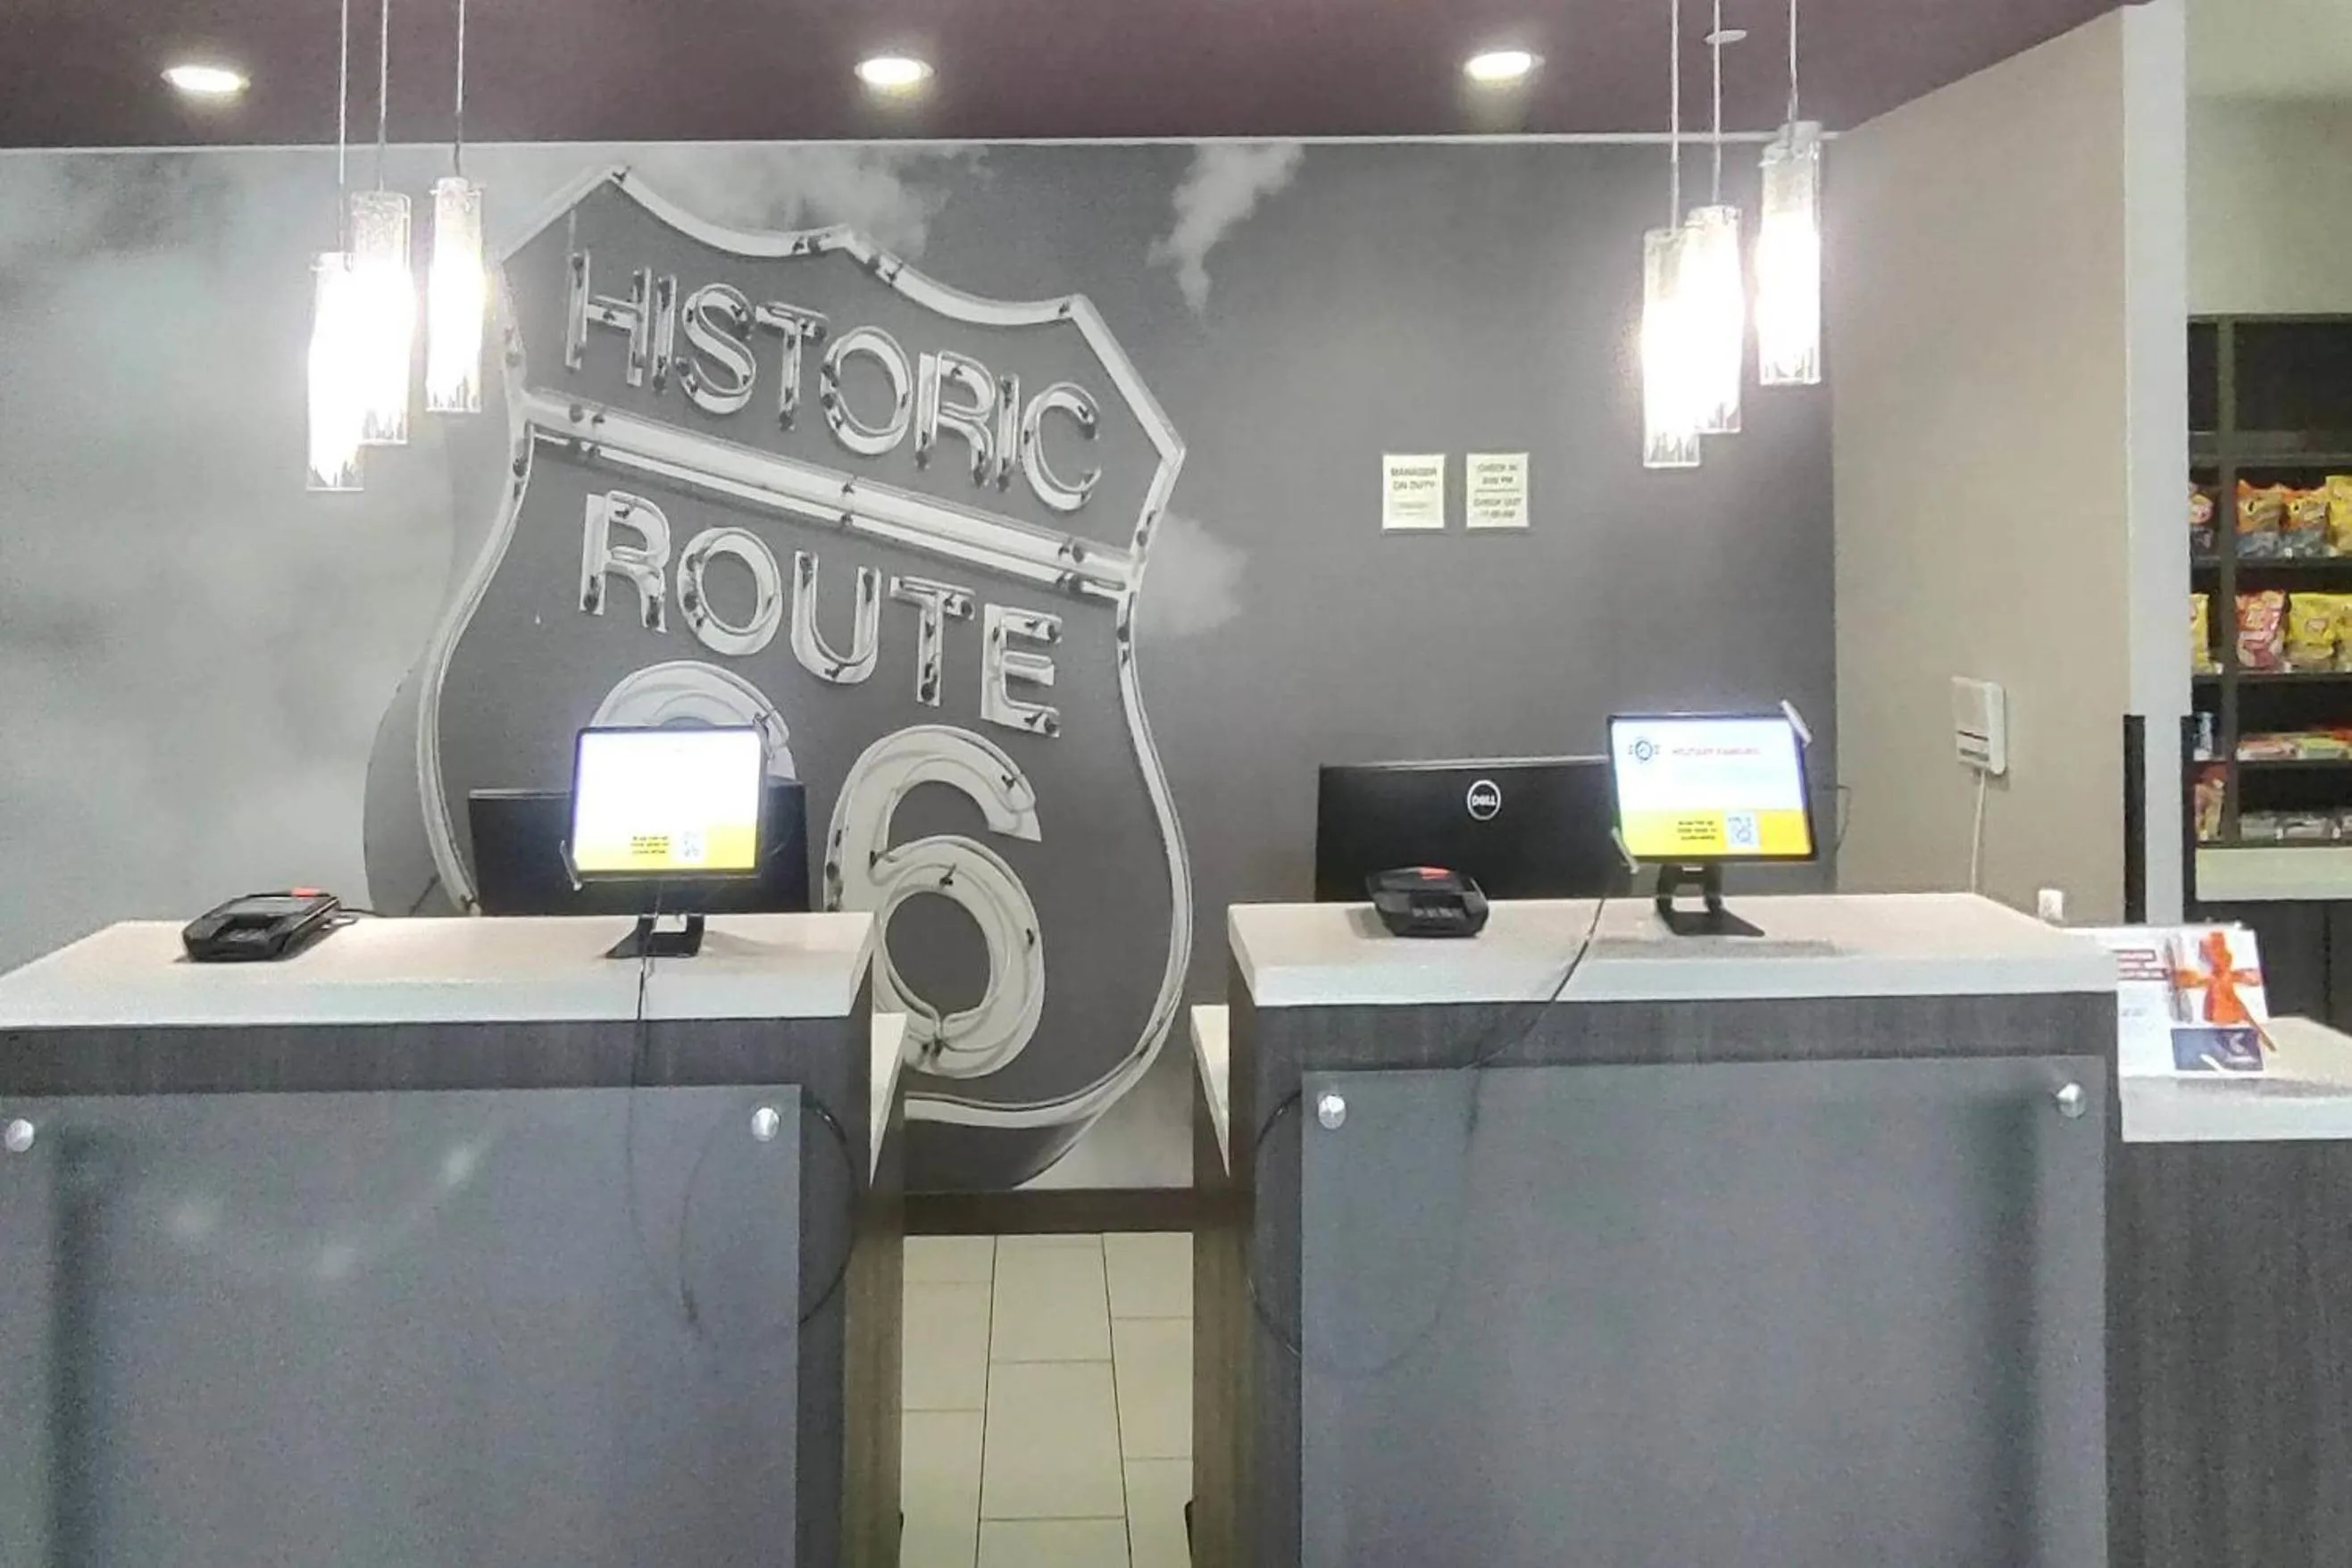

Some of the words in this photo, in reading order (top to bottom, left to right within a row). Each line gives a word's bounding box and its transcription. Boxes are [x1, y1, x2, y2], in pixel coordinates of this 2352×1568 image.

[564, 249, 1103, 512] HISTORIC
[579, 488, 1064, 738] ROUTE
[1472, 794, 1497, 806] DELL
